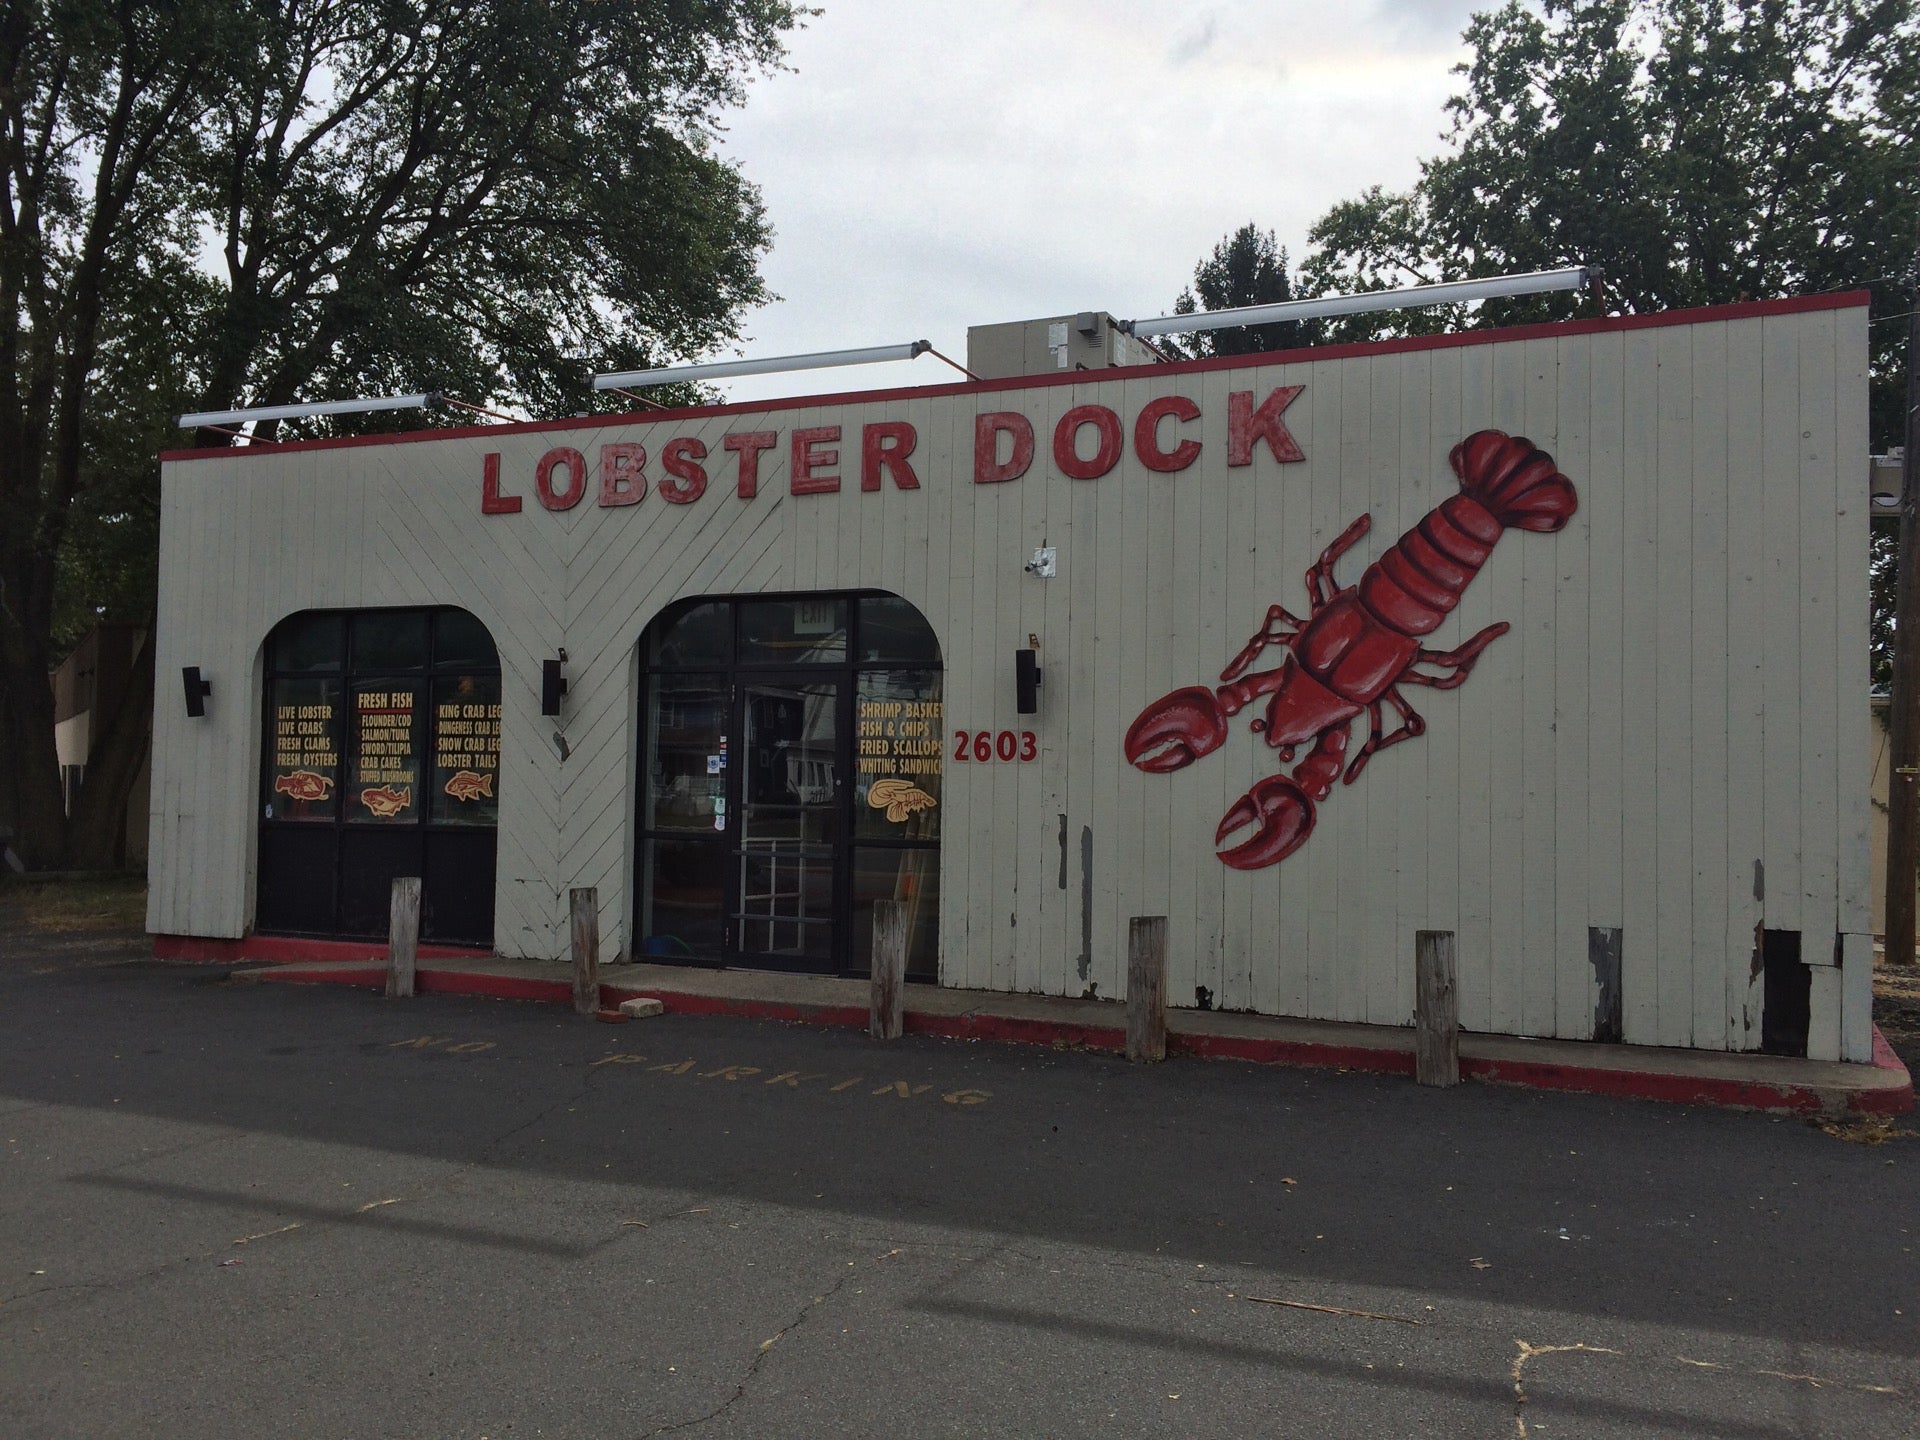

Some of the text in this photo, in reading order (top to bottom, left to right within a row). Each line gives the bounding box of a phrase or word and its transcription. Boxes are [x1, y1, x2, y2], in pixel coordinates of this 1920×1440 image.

[482, 384, 1307, 515] LOBSTER DOCK
[358, 692, 413, 709] FRESH FISH
[278, 706, 332, 719] LIVE LOBSTER
[439, 705, 460, 718] KING
[463, 705, 485, 718] CRAB
[861, 703, 901, 718] SHRIMP
[361, 714, 412, 727] FLOUNDER/COD
[278, 722, 323, 735] LIVE CRABS
[439, 721, 473, 735] DUNGENESS
[475, 721, 491, 735] CRAB
[861, 721, 930, 736] FISH & CHIPS
[361, 729, 410, 741] SALMON/TUNA
[277, 737, 330, 750] FRESH CLAMS
[438, 738, 462, 751] SNOW
[464, 738, 485, 751] CRAB
[860, 740, 943, 755] FRIED SCALLOPS
[954, 731, 1038, 762] 2603
[277, 753, 338, 766] FRESH OYSTERS
[360, 756, 401, 769] CRAB CAKES
[437, 754, 497, 768] LOBSTER TAILS
[860, 758, 897, 774] WHITING
[360, 771, 414, 783] STUFFED MUSHROOMS
[389, 1036, 994, 1105] NO PARKING
